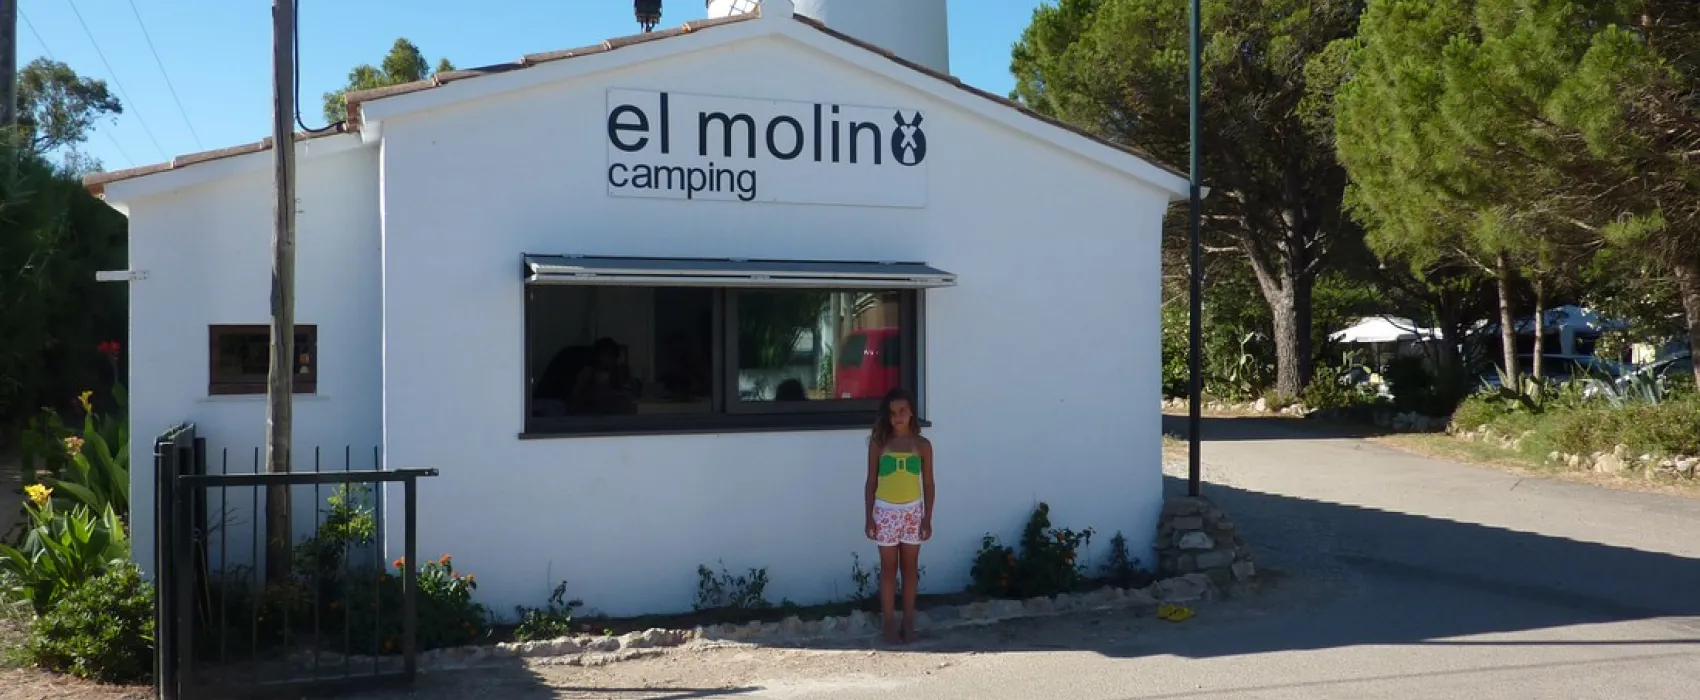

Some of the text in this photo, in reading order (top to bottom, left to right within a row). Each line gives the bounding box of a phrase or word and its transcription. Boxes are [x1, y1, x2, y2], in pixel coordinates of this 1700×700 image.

[607, 91, 927, 167] el molino
[607, 161, 757, 202] camping
